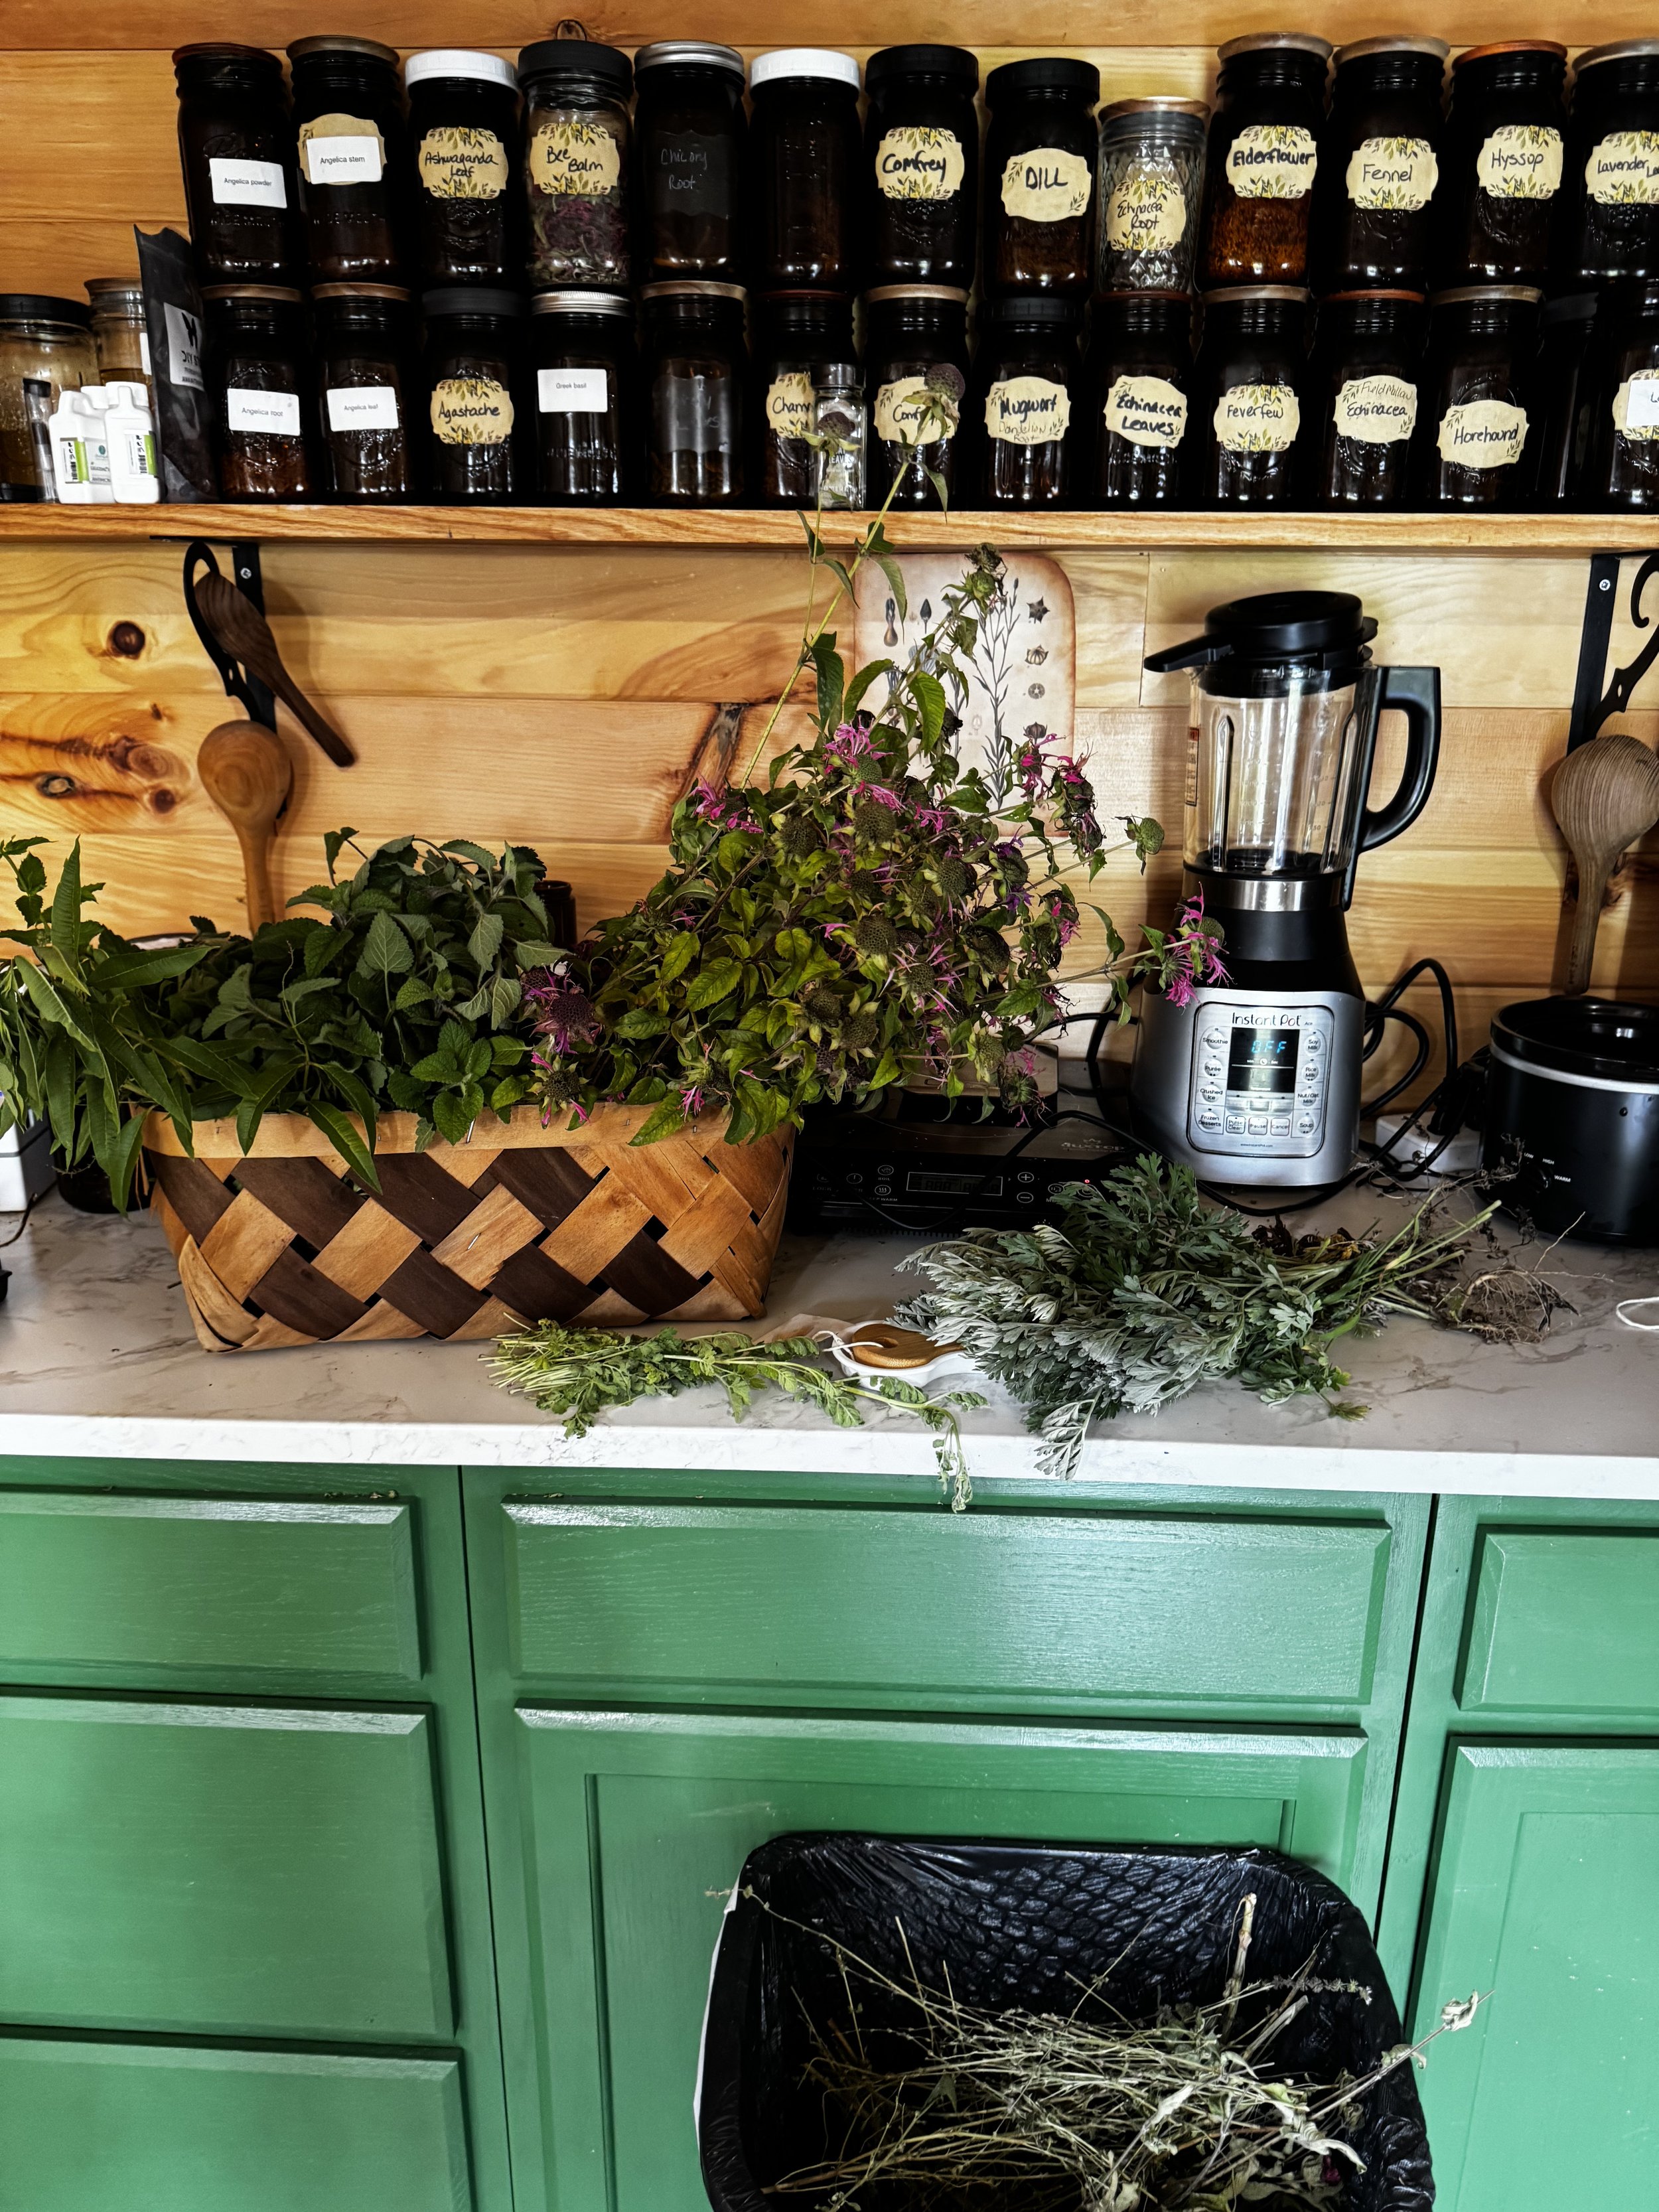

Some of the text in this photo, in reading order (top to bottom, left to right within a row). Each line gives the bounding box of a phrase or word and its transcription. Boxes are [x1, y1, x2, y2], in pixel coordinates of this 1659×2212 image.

[425, 151, 499, 166] Ashwaganda
[547, 145, 571, 164] Bee
[1233, 147, 1315, 167] Elderflower
[1492, 148, 1544, 171] Hyssop
[450, 165, 474, 178] Leaf
[568, 159, 603, 172] Balm
[882, 150, 946, 183] Comfrey
[1597, 155, 1648, 174] Lavender
[669, 175, 695, 189] Root
[1025, 167, 1068, 190] DILL
[1362, 164, 1412, 183] Fennel
[1131, 214, 1159, 230] Root
[1361, 381, 1386, 395] Field
[438, 401, 500, 424] Agastache
[1116, 394, 1182, 418] Echinacea
[1228, 404, 1283, 419] Feverfew
[1347, 402, 1407, 417] Echinacea
[1121, 415, 1174, 436] Leaves
[1454, 422, 1518, 445] Horehound
[1232, 1012, 1276, 1026] Instant
[1280, 1014, 1301, 1027] Pot
[1252, 1040, 1287, 1054] OFF
[1554, 1174, 1571, 1183] WARM
